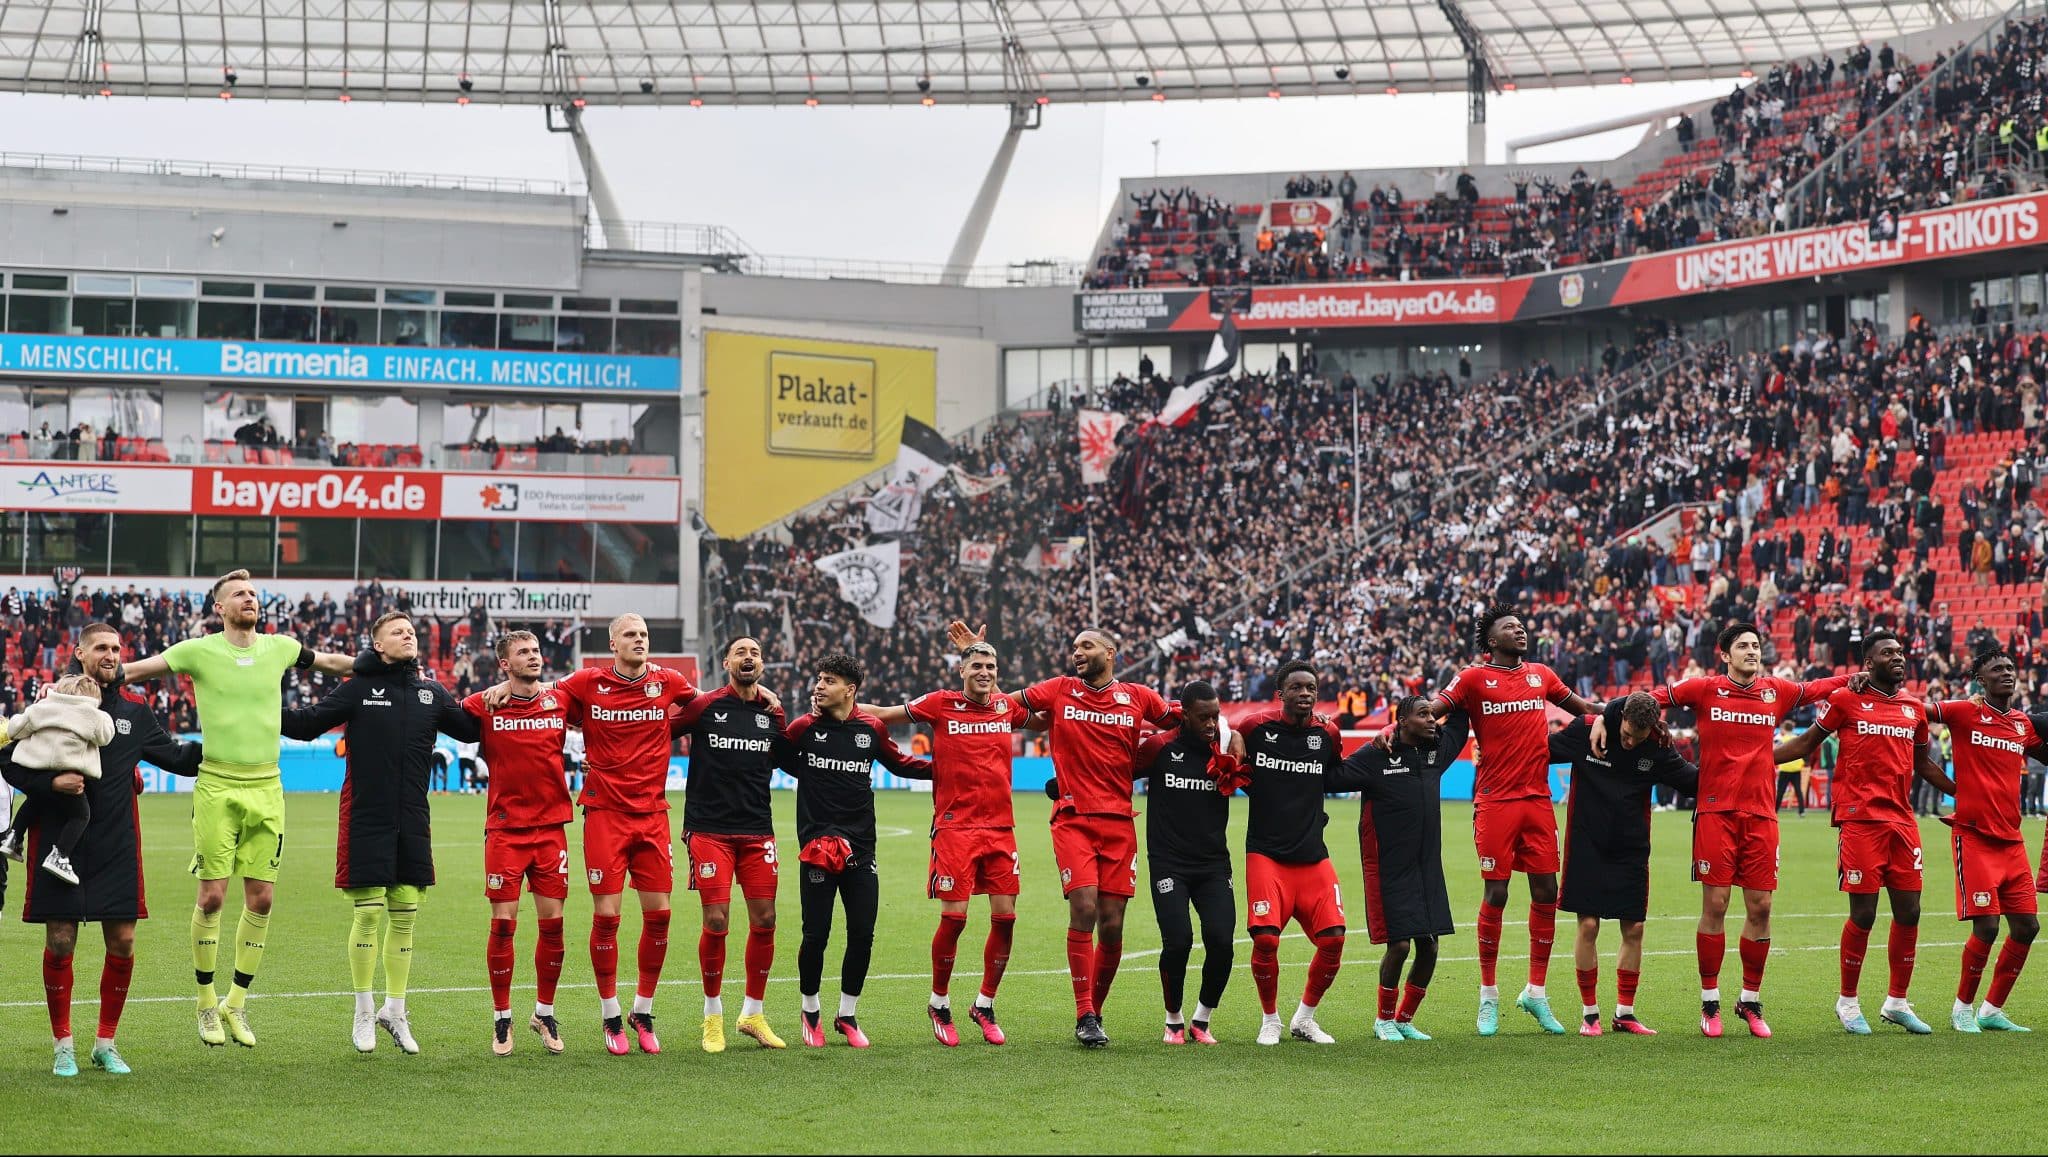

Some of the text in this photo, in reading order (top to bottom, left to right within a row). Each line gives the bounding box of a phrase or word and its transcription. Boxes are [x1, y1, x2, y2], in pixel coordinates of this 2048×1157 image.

[1675, 201, 2038, 292] UNSERE WERKSELF-TRIKOTS
[1119, 294, 1138, 305] AUF
[1139, 293, 1163, 305] DEM
[20, 343, 180, 373] MENSCHLICH.
[220, 343, 369, 379] Barmenia
[384, 356, 482, 382] EINFACH.
[491, 359, 638, 388] MENSCHLICH.
[778, 373, 868, 406] Plakat-
[777, 410, 868, 431] verkauft.de
[212, 470, 426, 516] bayer04.de
[362, 698, 393, 707] Barmenia
[591, 705, 665, 721] Barmenia
[1481, 696, 1544, 716] Barmenia
[492, 715, 564, 731] Barmenia
[1064, 705, 1134, 727] Barmenia
[948, 719, 1012, 735] Barmenia
[1255, 751, 1323, 775] Barmenia
[276, 833, 283, 858] 1
